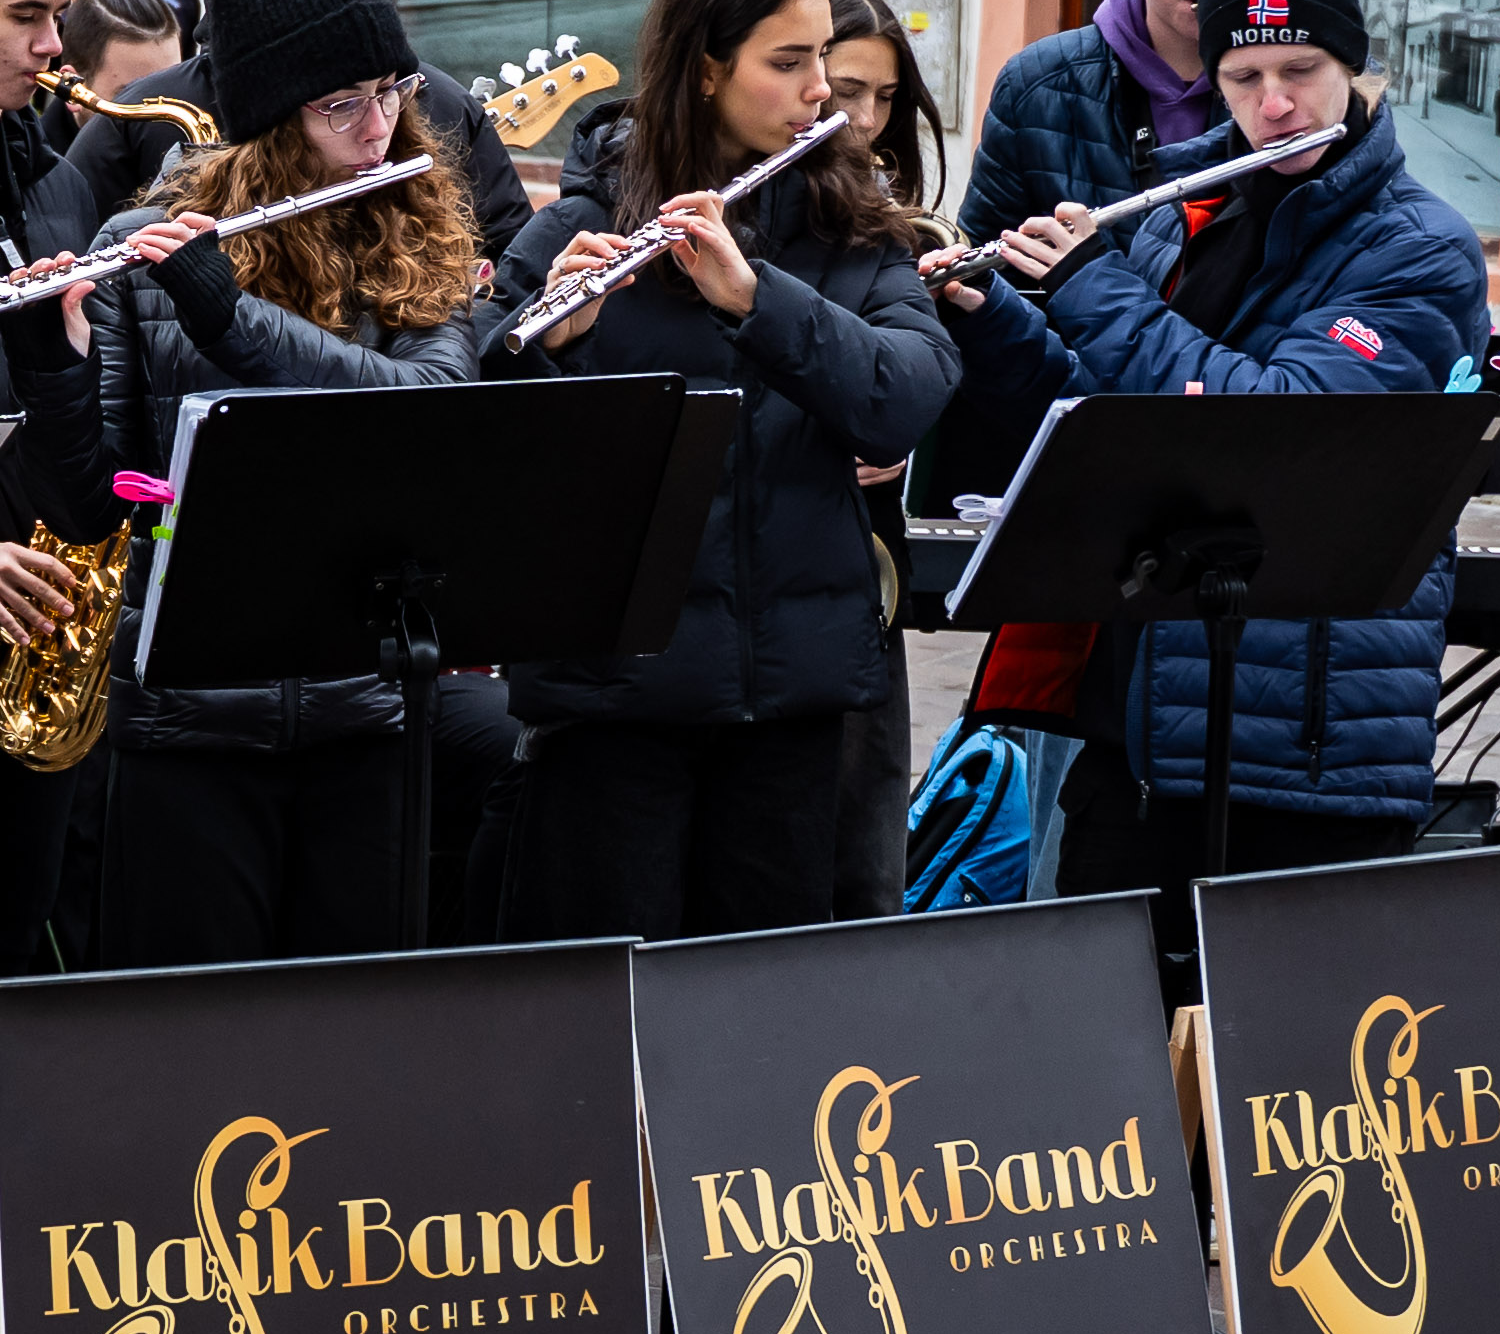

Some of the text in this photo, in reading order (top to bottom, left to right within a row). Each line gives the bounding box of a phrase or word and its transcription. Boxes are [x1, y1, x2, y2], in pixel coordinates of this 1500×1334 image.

[1230, 28, 1310, 47] NORGE
[933, 1116, 1158, 1225] Band
[339, 1179, 604, 1288] Band
[949, 1217, 1159, 1274] ORCHESTRA
